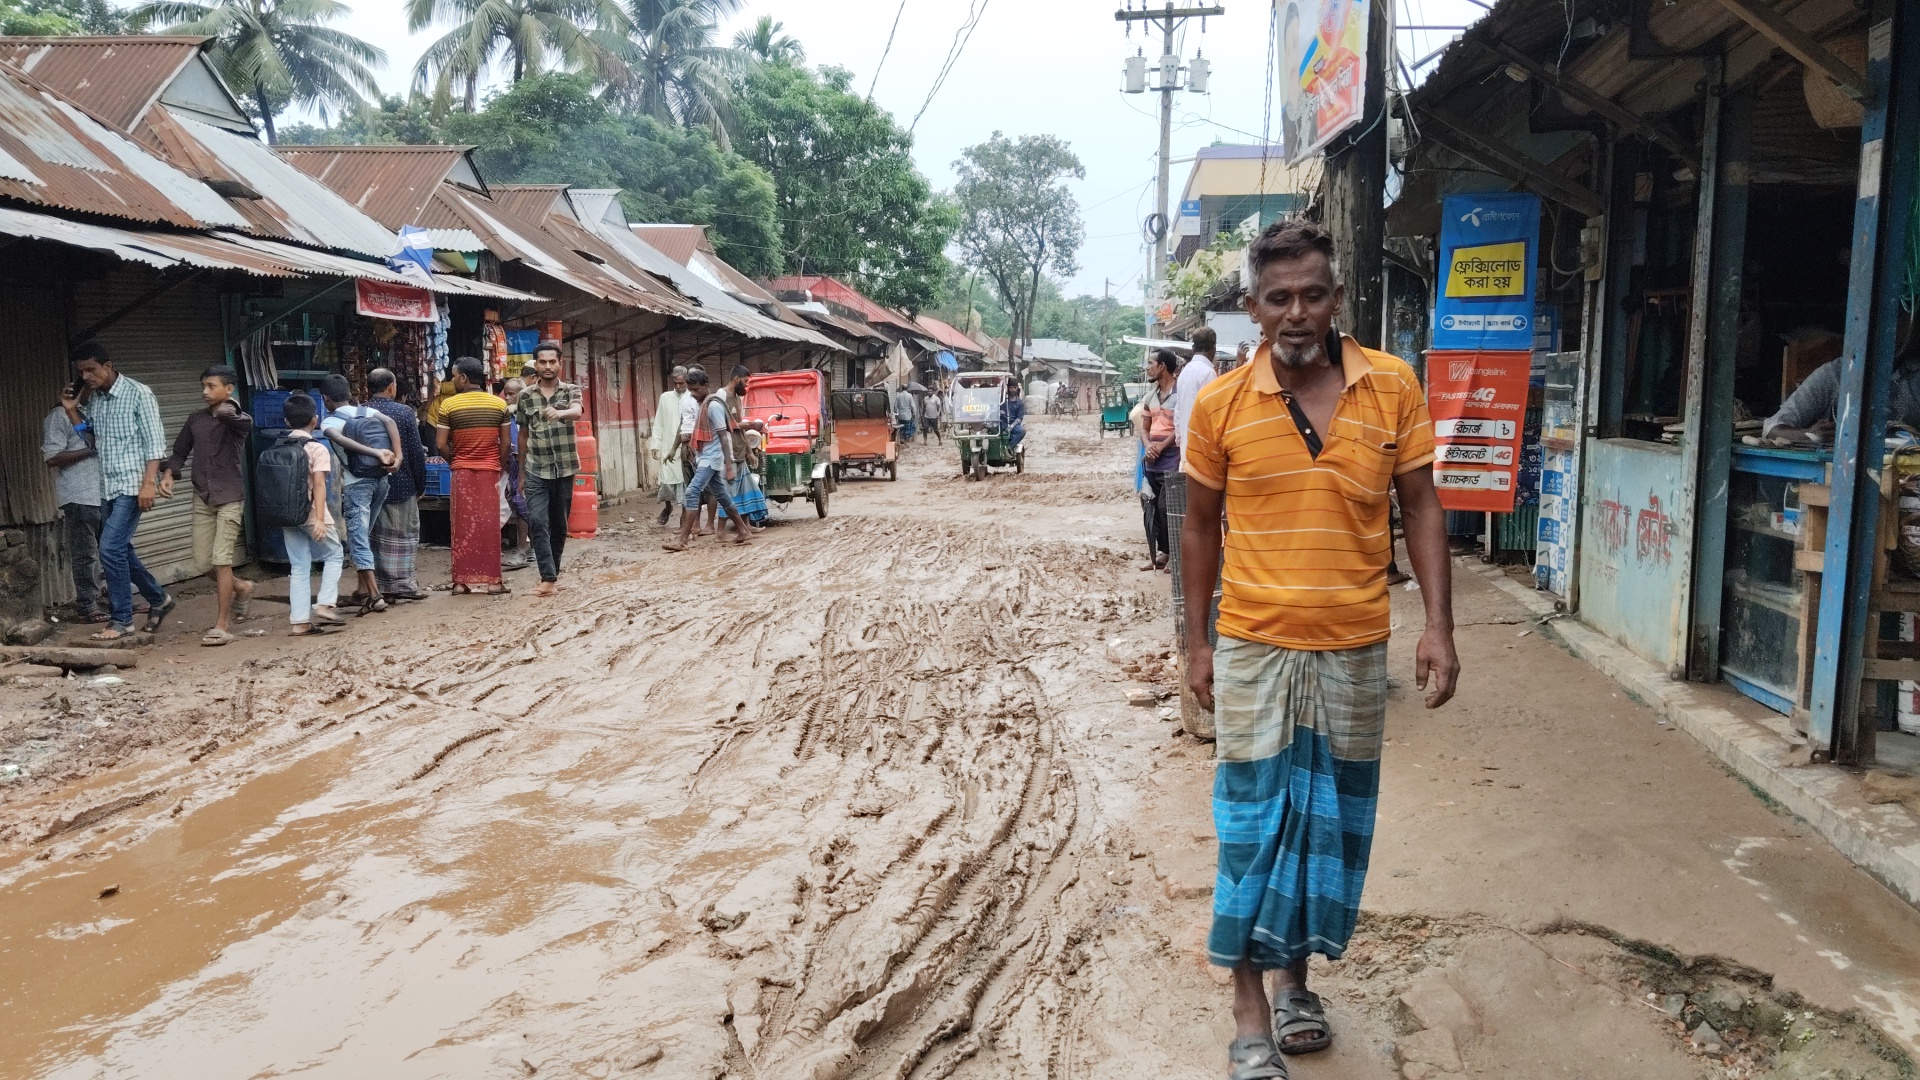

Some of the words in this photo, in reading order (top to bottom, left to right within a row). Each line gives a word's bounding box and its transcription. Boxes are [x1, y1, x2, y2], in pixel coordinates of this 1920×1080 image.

[1454, 256, 1521, 275] ফ্লেক্সিলোড
[1463, 275, 1490, 288] করা
[1493, 276, 1512, 288] হয়
[1469, 367, 1507, 377] banglalink
[1441, 391, 1472, 400] FASTEST
[1472, 387, 1497, 401] 4G
[1453, 421, 1483, 434] রিচার্জ
[1445, 447, 1487, 459] ইন্টারনেট
[1494, 451, 1511, 459] 4G
